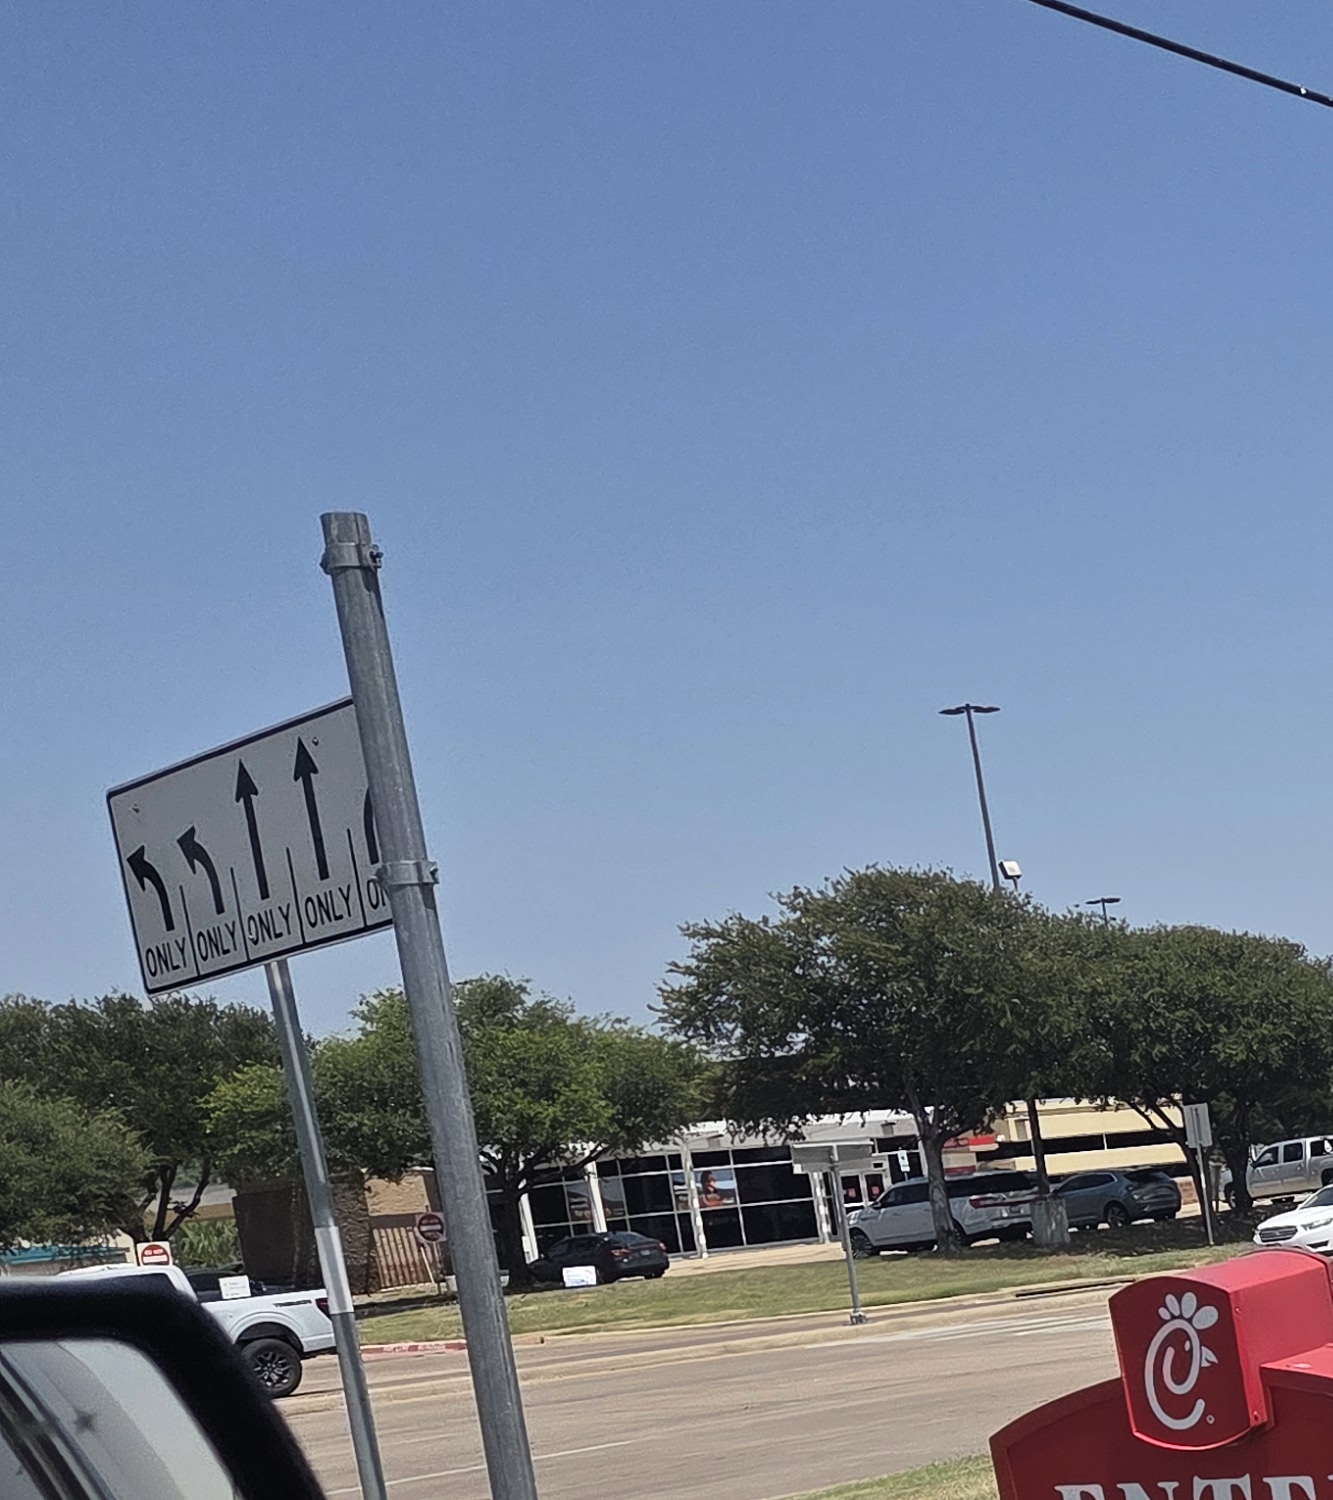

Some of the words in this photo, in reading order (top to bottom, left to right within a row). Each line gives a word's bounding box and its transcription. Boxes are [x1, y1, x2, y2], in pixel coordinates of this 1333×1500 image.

[145, 937, 187, 977] ONLY
[196, 921, 237, 962] ONLY
[247, 903, 291, 946] ONLY
[304, 884, 351, 928] ONLY
